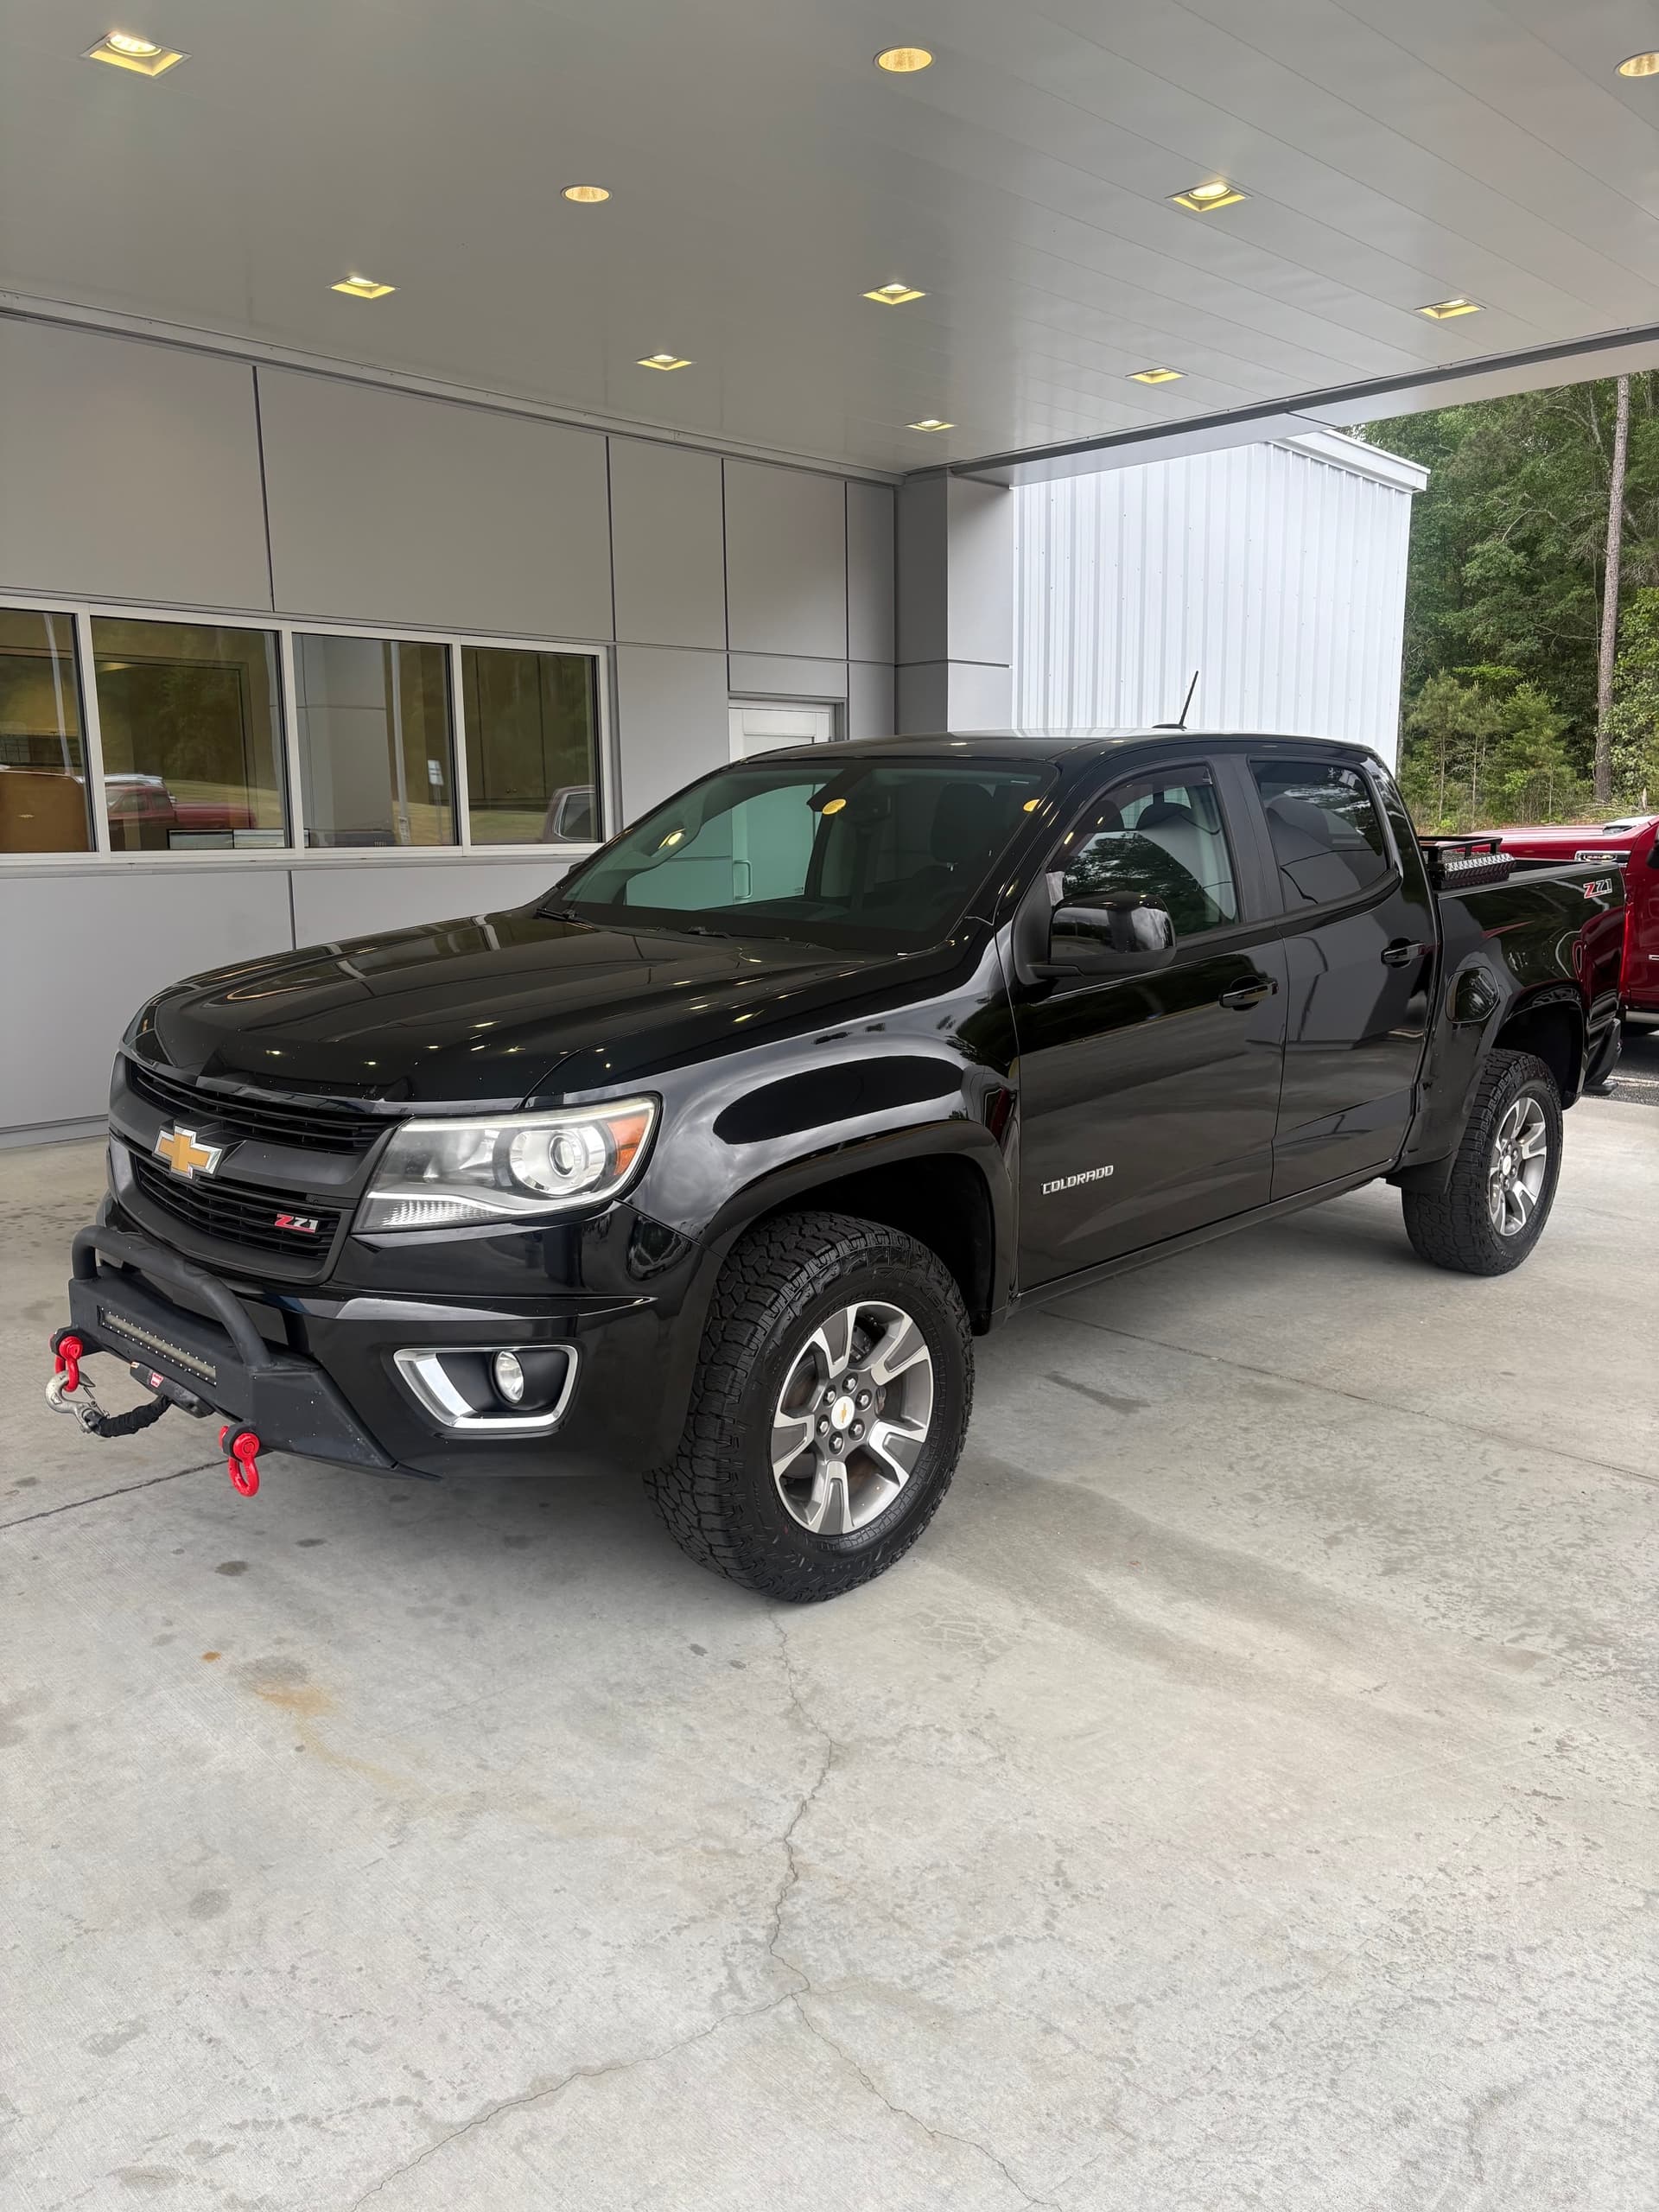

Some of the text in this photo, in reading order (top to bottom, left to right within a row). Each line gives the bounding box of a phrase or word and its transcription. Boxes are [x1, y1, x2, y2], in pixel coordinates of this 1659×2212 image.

[1583, 878, 1613, 899] Z71
[1041, 1165, 1114, 1195] COLORADO
[274, 1212, 319, 1234] Z71
